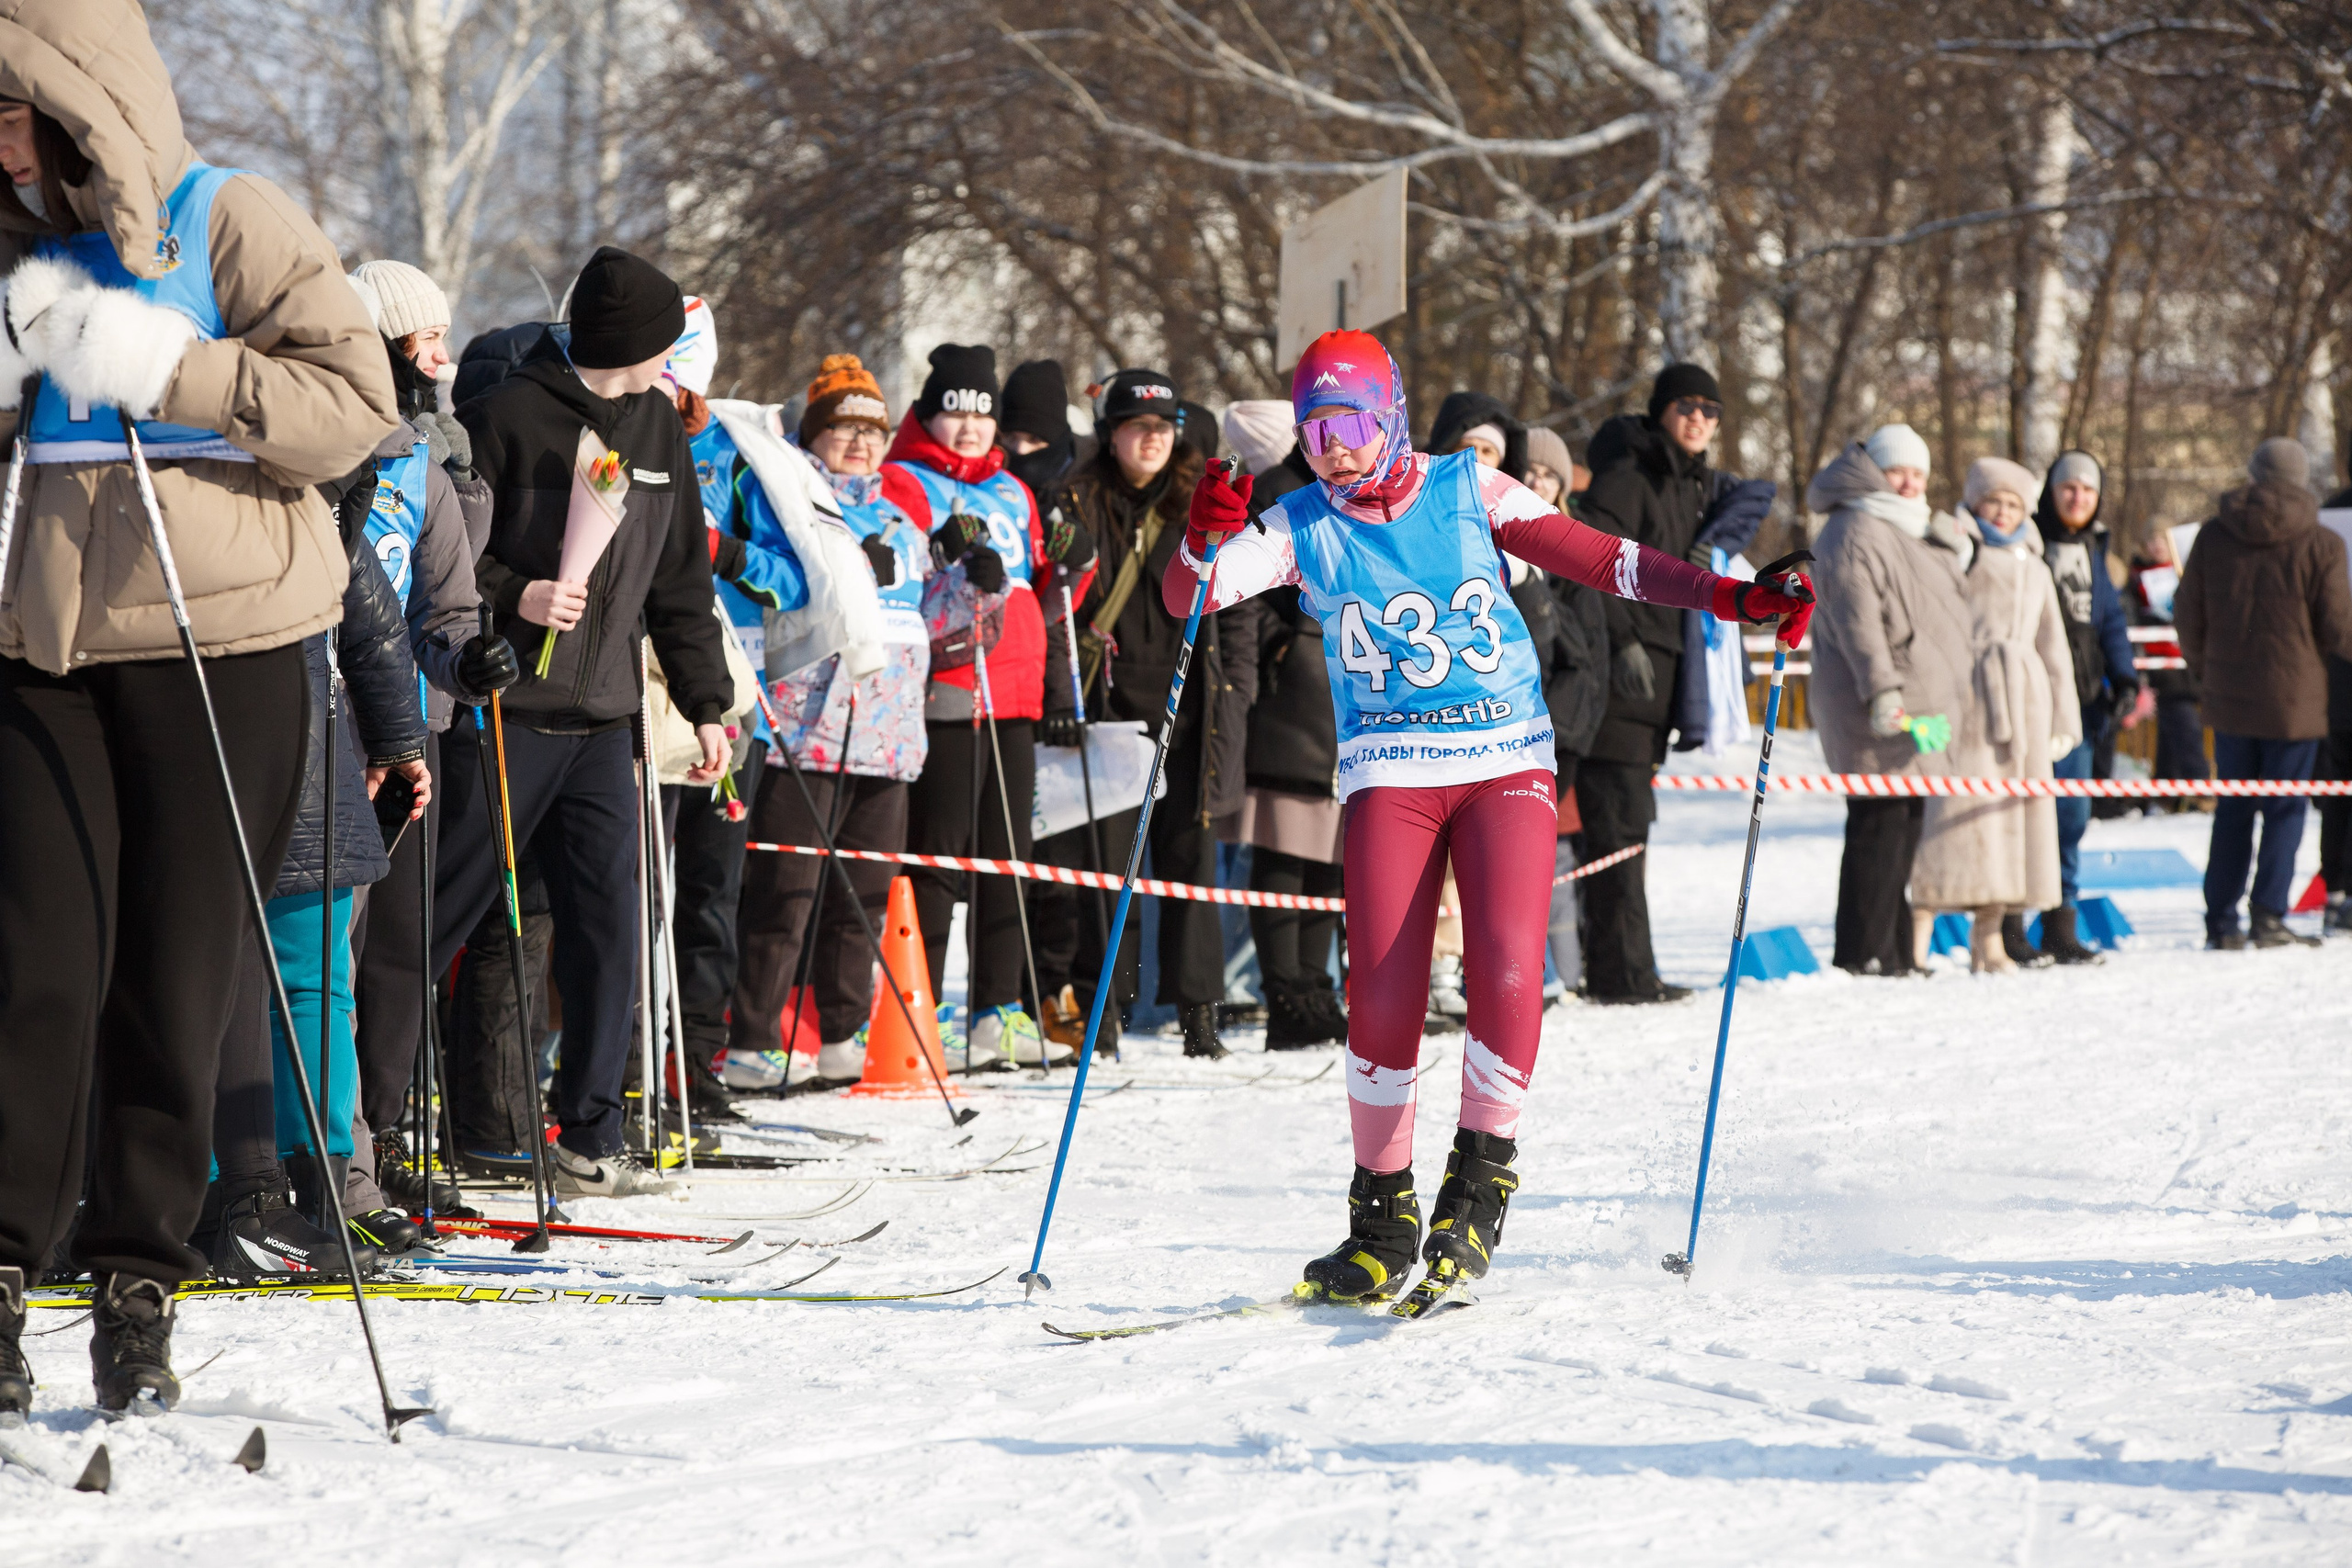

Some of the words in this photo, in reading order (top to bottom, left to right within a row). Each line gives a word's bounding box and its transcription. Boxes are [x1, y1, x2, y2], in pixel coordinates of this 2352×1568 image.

[942, 388, 993, 415] OMG
[1339, 576, 1505, 694] 433
[329, 695, 336, 710] XC
[1359, 696, 1512, 726] ТЮМЕНЬ
[1361, 745, 1415, 763] ГЛАВЫ
[1420, 745, 1494, 760] ГОРОДА
[264, 1235, 311, 1258] NORDWAY
